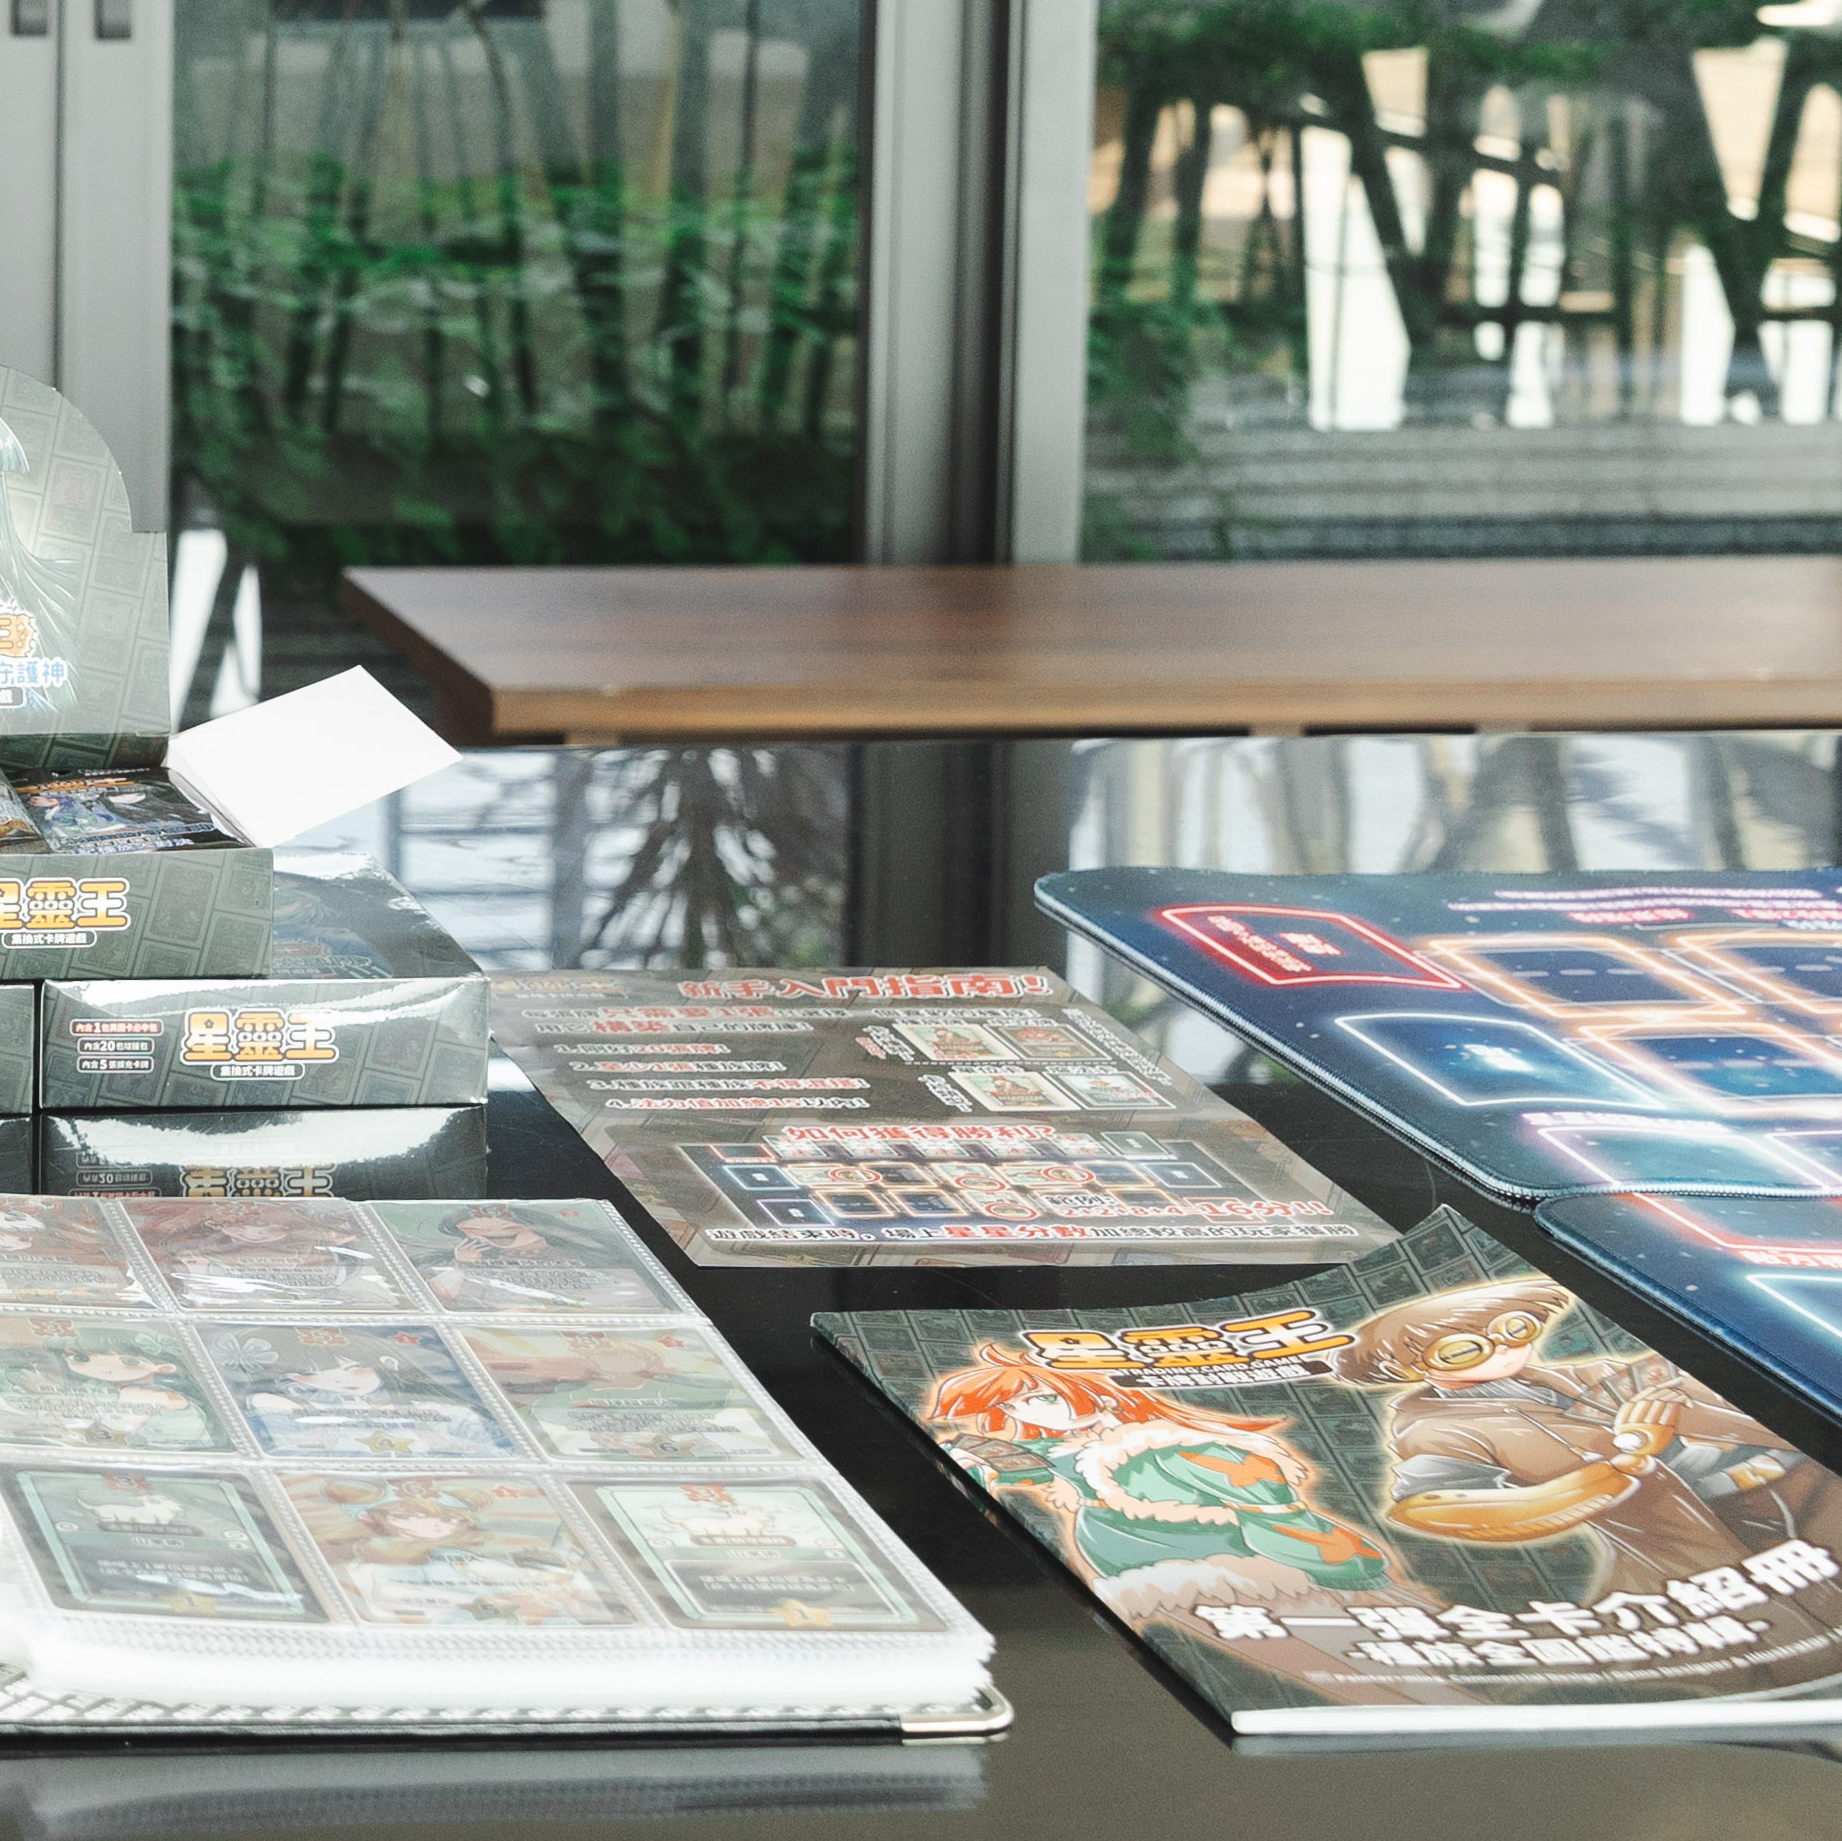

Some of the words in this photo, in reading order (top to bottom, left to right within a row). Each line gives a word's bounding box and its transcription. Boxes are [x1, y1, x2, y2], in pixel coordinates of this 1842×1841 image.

[680, 973, 1049, 999] 新手入門指南!
[183, 1010, 337, 1061] 星靈王
[781, 1125, 1056, 1142] 如何獲得勝利?
[1023, 1309, 1355, 1370] 星靈王
[1193, 1537, 1840, 1641] 第一彈全卡介紹冊
